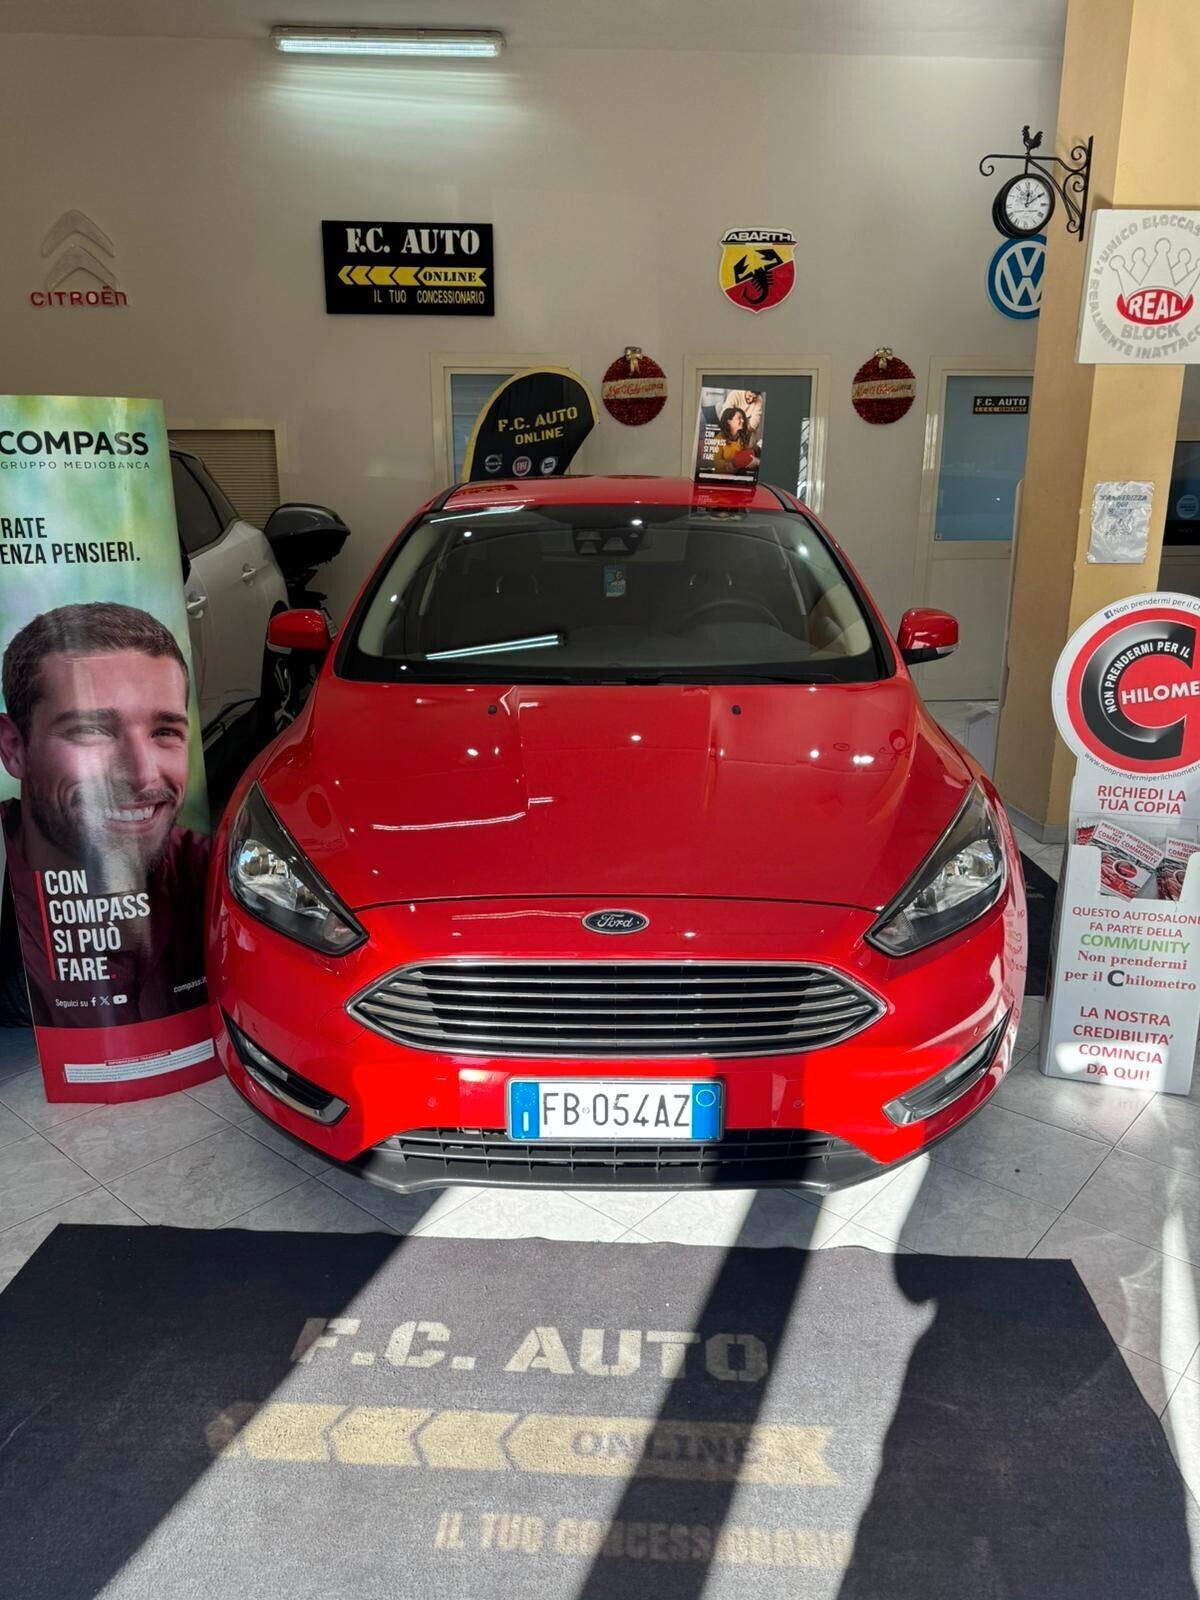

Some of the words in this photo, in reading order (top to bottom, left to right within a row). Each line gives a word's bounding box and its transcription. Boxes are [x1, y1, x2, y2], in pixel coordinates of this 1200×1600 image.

[346, 227, 391, 253] F.C.
[401, 229, 480, 255] AUTO
[727, 231, 791, 241] ABARTH
[423, 271, 477, 282] ONLINE
[374, 290, 382, 303] IL
[389, 290, 407, 303] TUO
[416, 290, 485, 304] CONCESSIONARIO
[1129, 291, 1181, 320] REAL
[1121, 323, 1180, 341] BLOCK
[998, 398, 1026, 406] AUTO
[498, 417, 531, 432] F.C.
[535, 406, 578, 427] AUTO
[0, 430, 149, 456] COMPASS
[514, 426, 564, 445] ONLINE
[1, 461, 57, 470] GRUPPO
[64, 461, 150, 470] MEDIOBANCA
[1, 517, 47, 538] RATE
[51, 541, 141, 564] PENSIERI.
[1113, 604, 1129, 615] Non
[1130, 597, 1171, 612] prendermi
[1172, 598, 1184, 608] per
[1186, 599, 1192, 608] il
[1157, 641, 1178, 653] PER
[1180, 645, 1191, 658] IL
[1105, 642, 1154, 688] PRENDERMI
[1103, 691, 1117, 713] NON
[1097, 785, 1163, 800] RICHIEDI
[1168, 790, 1186, 801] LA
[1099, 798, 1129, 811] TUA
[1134, 801, 1181, 814] COPIA
[44, 869, 88, 895] CON
[48, 892, 151, 925] COMPASS
[1072, 906, 1120, 918] QUESTO
[597, 913, 633, 928] Ford
[1089, 921, 1103, 932] FA
[1107, 923, 1143, 935] PARTE
[1146, 927, 1183, 938] DELLA
[53, 929, 73, 953] SI
[79, 921, 121, 952] PUÒ
[1080, 934, 1190, 954] COMMUNITY
[1078, 950, 1106, 963] Non
[1110, 953, 1187, 970] prendermi
[1064, 970, 1088, 982] per
[1092, 970, 1103, 982] il
[1107, 970, 1197, 991] Chilometro
[55, 998, 79, 1008] Seguici
[80, 999, 89, 1007] su
[1080, 1006, 1099, 1019] LA
[1104, 1009, 1171, 1026] NOSTRA
[1079, 1044, 1163, 1065] COMINCIA
[1086, 1063, 1108, 1076] DA
[1113, 1067, 1150, 1081] QUI!
[504, 1326, 769, 1382] AUTO
[479, 1511, 545, 1554] TUO
